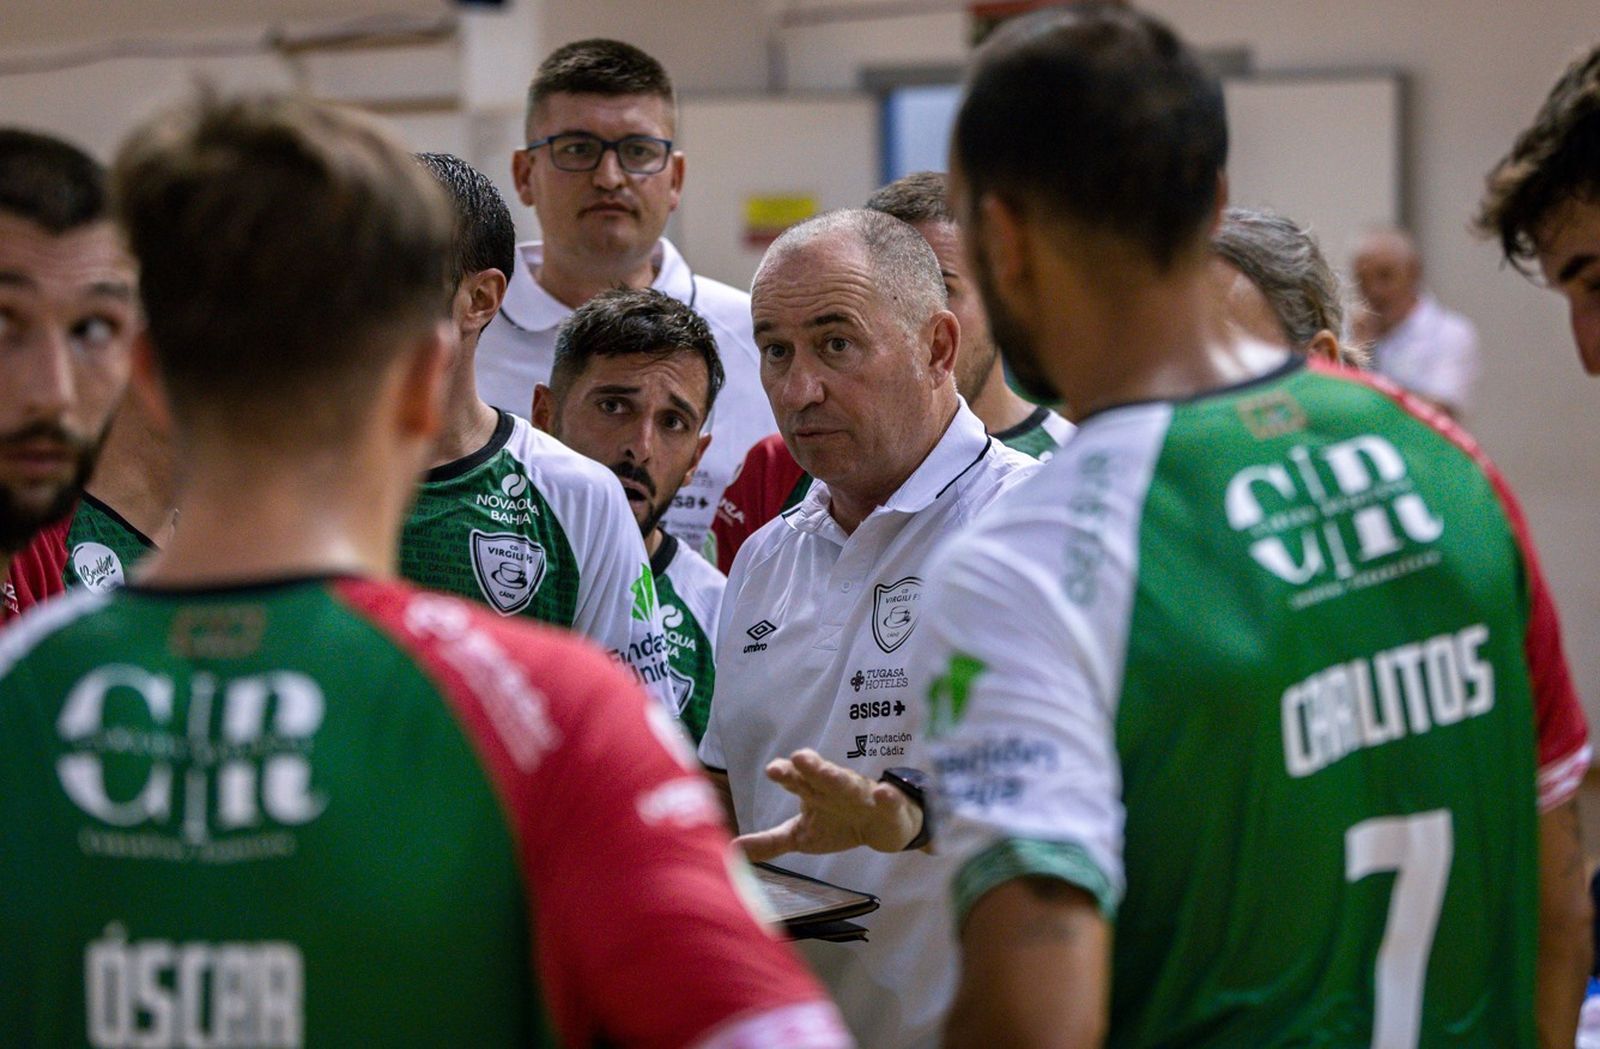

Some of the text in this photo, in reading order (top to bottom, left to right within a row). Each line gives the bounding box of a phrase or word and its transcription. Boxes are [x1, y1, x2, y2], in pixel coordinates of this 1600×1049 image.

[476, 494, 540, 516] NOVAQUA
[487, 546, 524, 561] VIRGILI
[743, 642, 768, 654] umbro
[867, 668, 905, 679] TUGASA
[864, 678, 909, 690] HOTELES
[1281, 623, 1496, 778] CARLITOS
[868, 733, 912, 744] Diputación
[868, 745, 905, 757] de Cádiz
[1344, 807, 1455, 1049] 7
